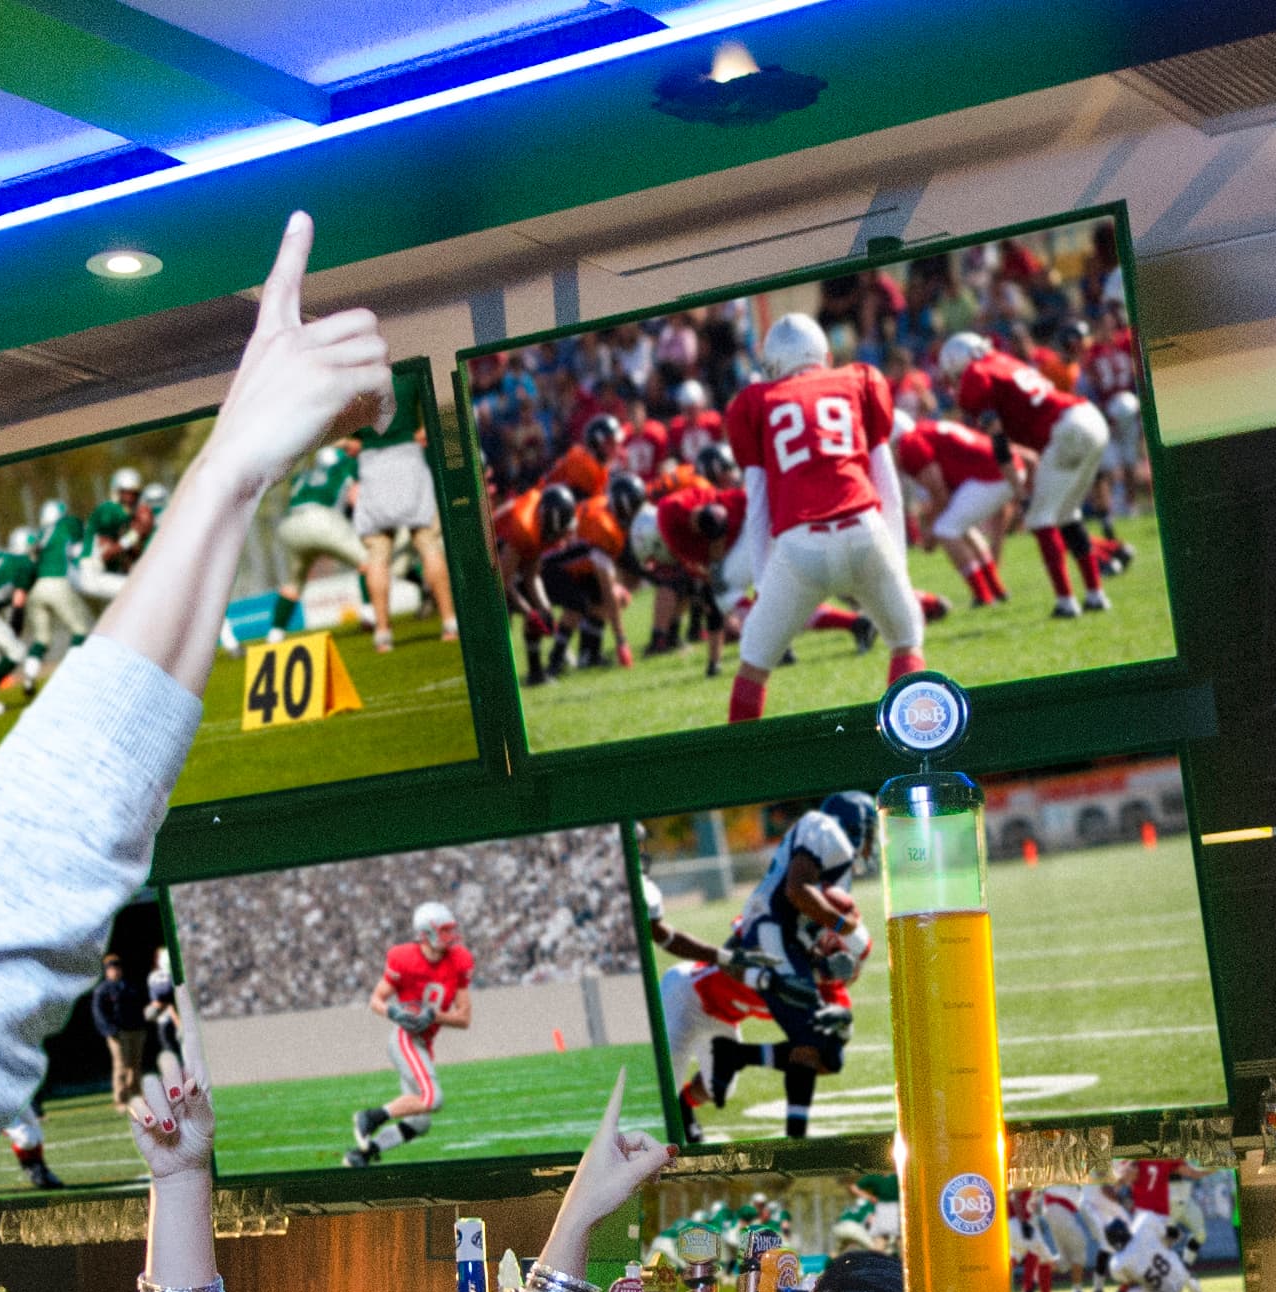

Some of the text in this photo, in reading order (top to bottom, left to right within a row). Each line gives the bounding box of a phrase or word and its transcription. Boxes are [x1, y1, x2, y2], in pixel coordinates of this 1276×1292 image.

[769, 396, 855, 474] 29
[247, 644, 314, 724] 40
[902, 706, 947, 725] D&B
[1147, 1165, 1159, 1192] 7
[947, 1195, 992, 1215] D&B
[1144, 1253, 1171, 1290] 58
